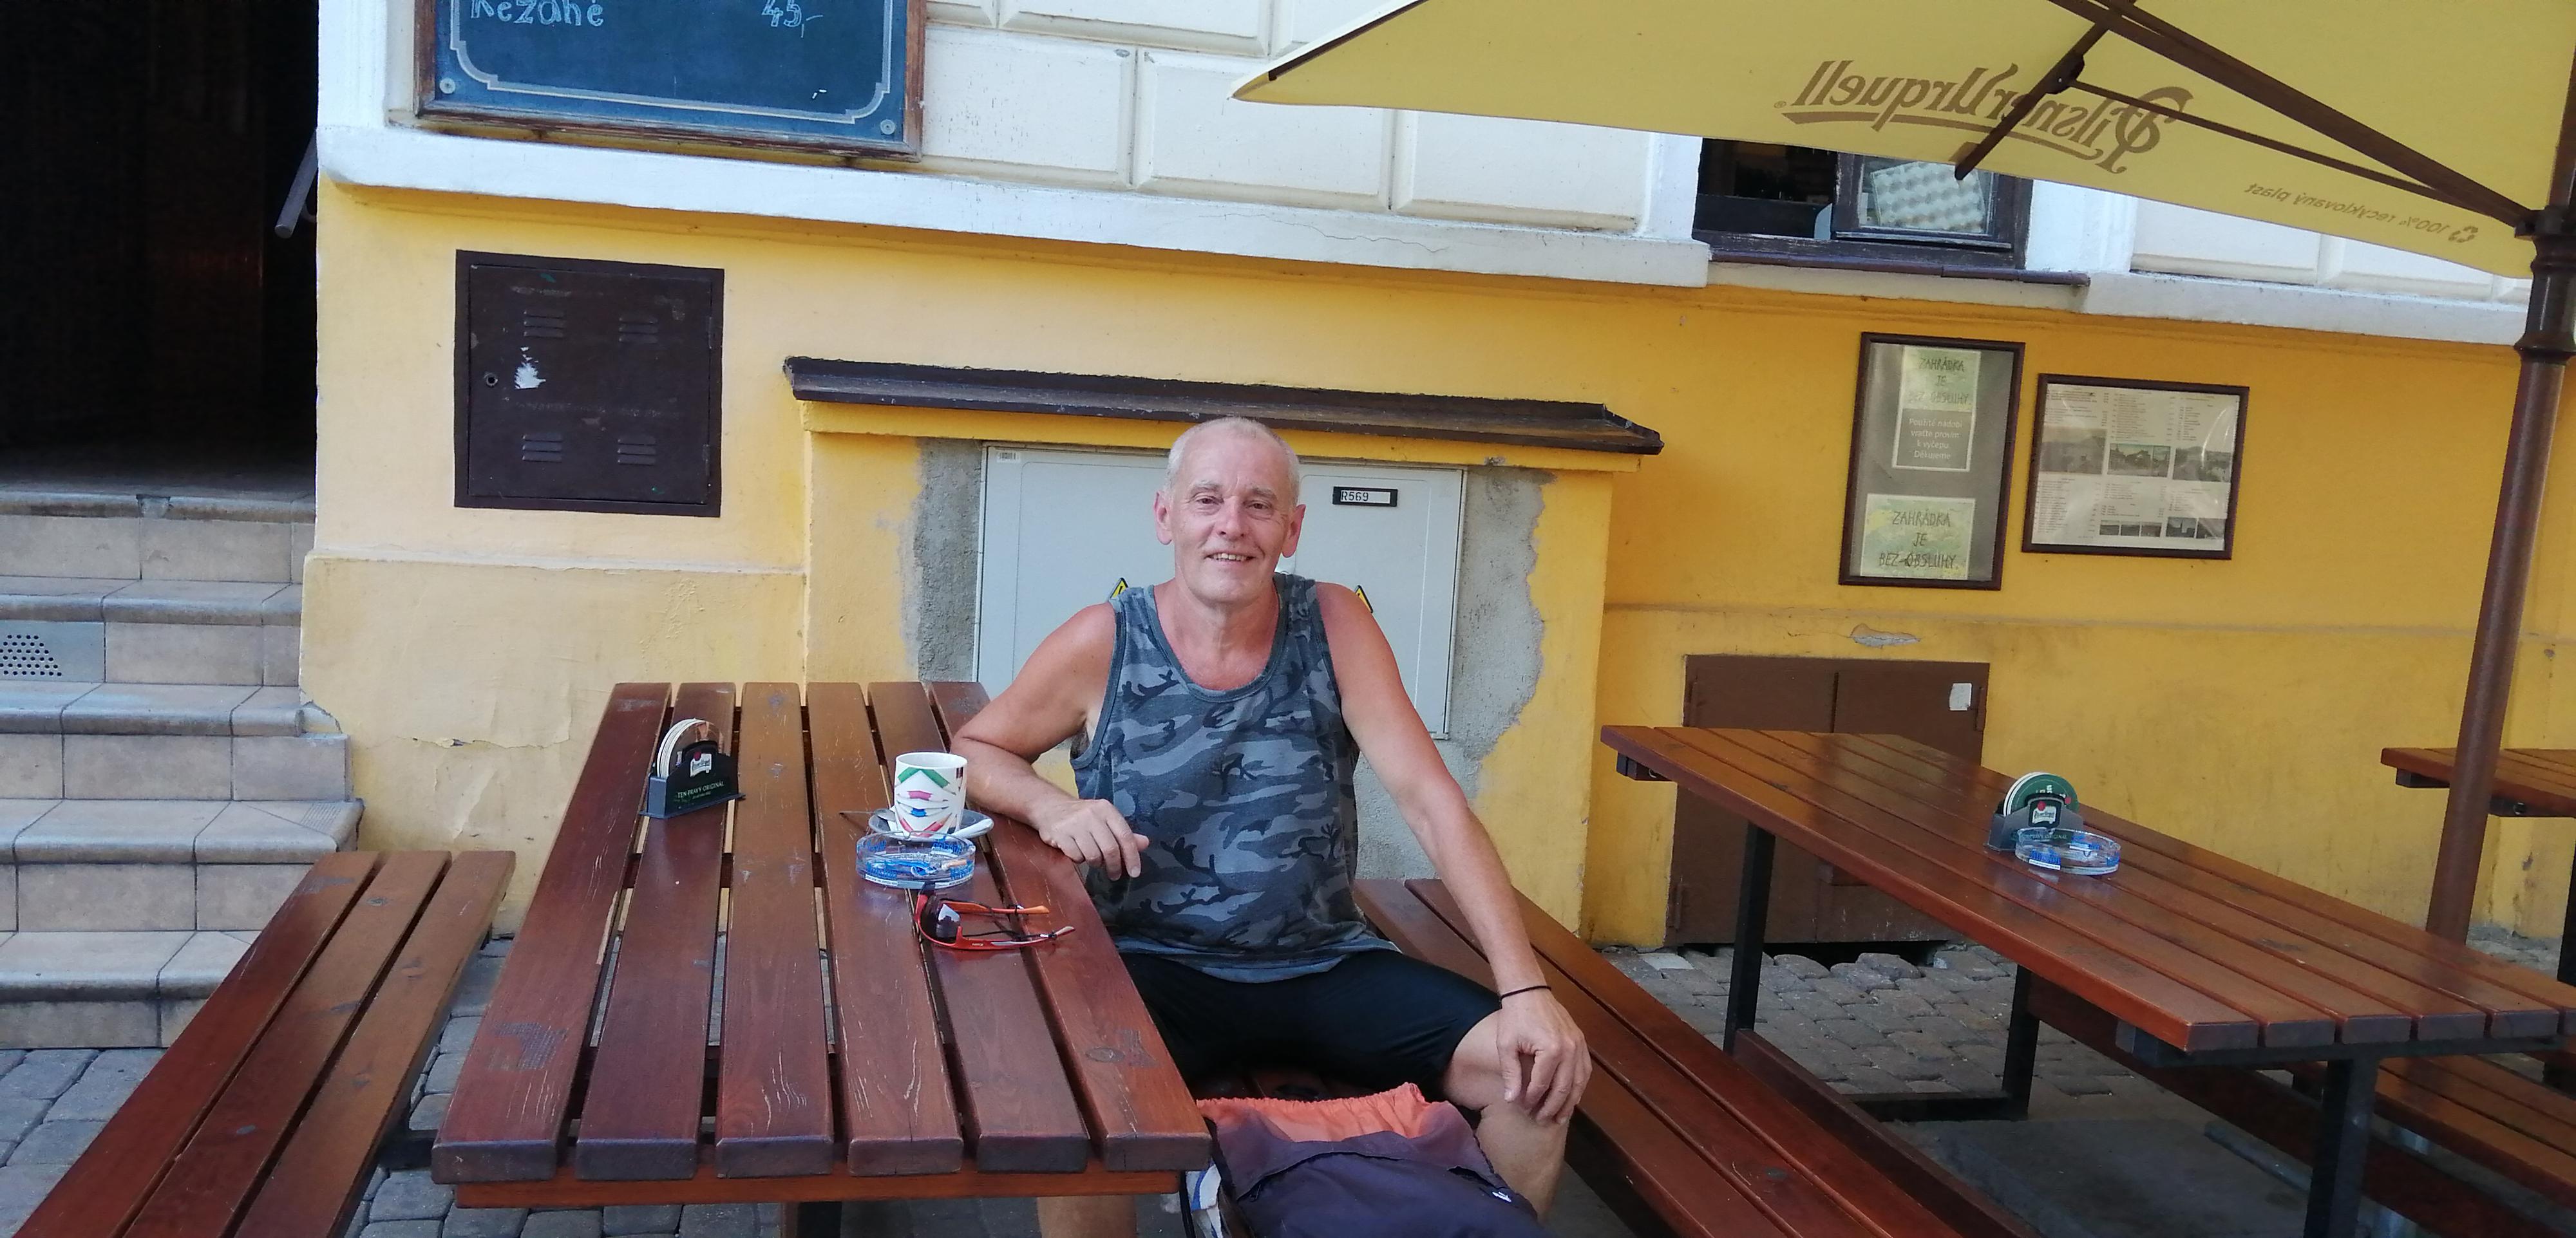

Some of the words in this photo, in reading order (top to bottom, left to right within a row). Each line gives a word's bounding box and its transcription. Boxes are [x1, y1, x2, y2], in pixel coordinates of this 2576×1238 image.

[1341, 491, 1368, 502] R569
[1892, 509, 1951, 528] ZAHRÁDKA
[1913, 532, 1927, 547] JE
[1879, 552, 1899, 567] BEZ
